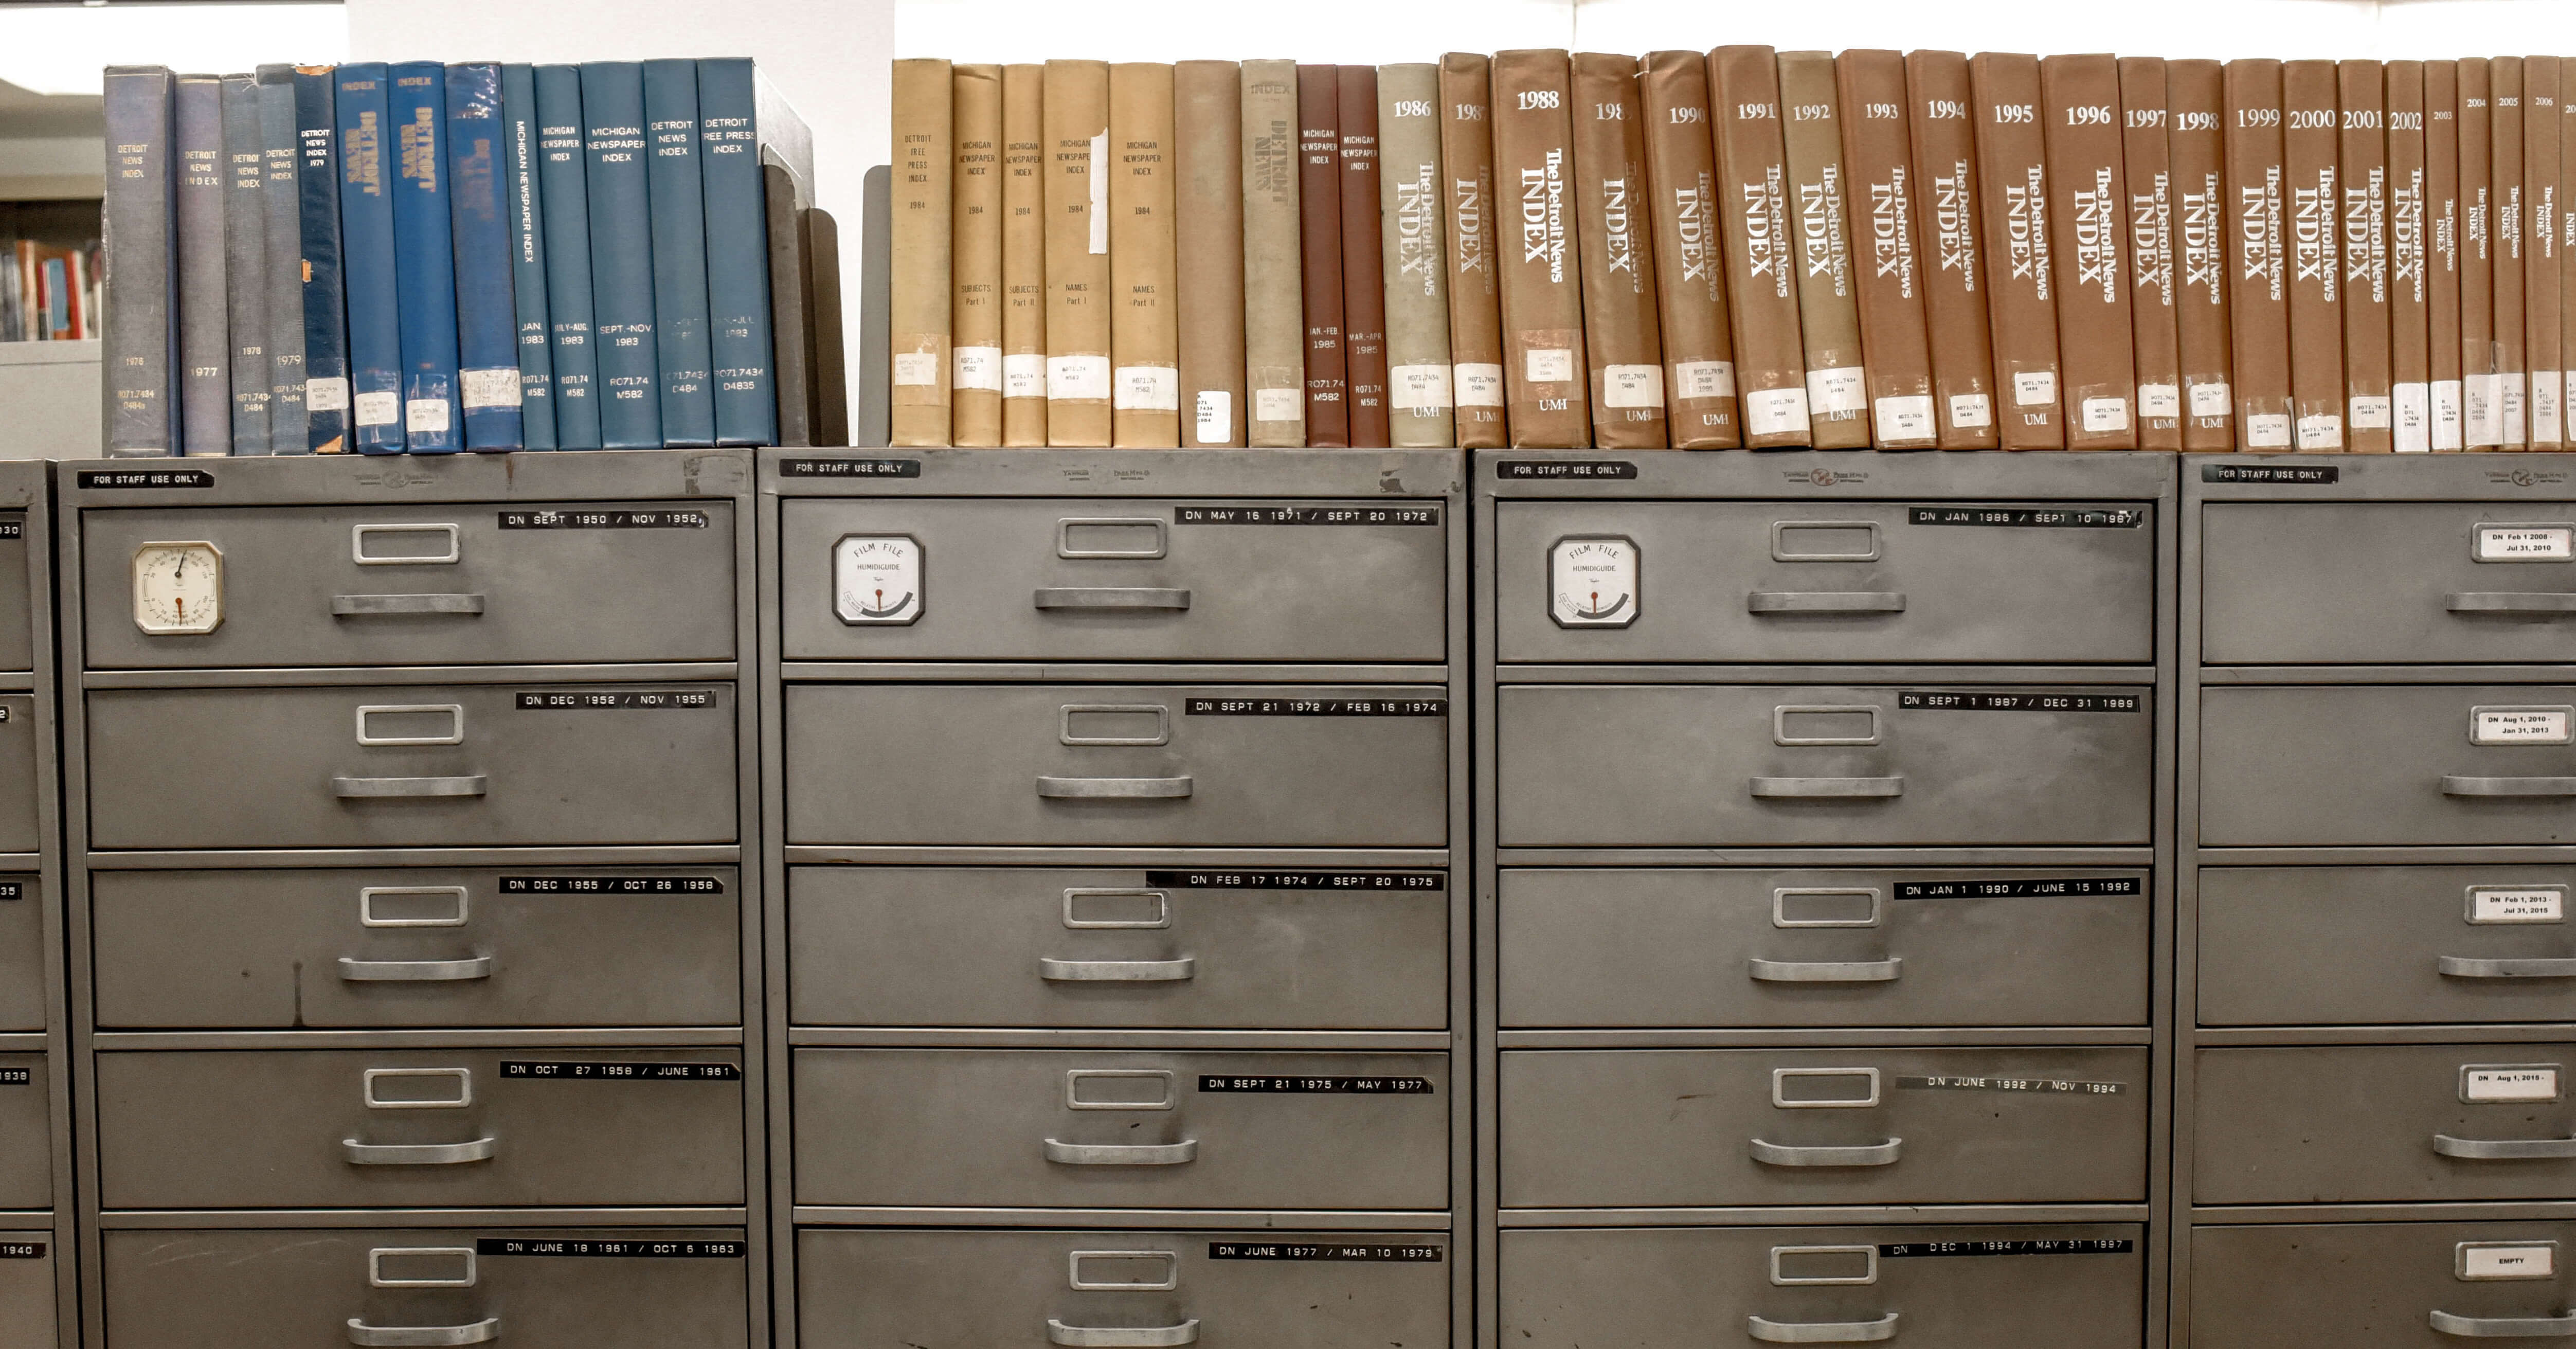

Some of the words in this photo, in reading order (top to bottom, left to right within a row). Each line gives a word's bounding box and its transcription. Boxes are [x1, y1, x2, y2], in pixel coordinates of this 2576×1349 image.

[1518, 91, 1559, 110] 1988
[2467, 98, 2485, 107] 2004
[2499, 98, 2518, 106] 2005
[2535, 97, 2553, 106] 2006
[1394, 100, 1430, 117] 1986
[1738, 103, 1776, 119] 1991
[1793, 104, 1830, 121] 1992
[1866, 103, 1898, 119] 1993
[1928, 100, 1967, 119] 1994
[1995, 104, 2033, 123] 1995
[2066, 105, 2111, 125] 1996
[2127, 110, 2166, 128] 1997
[2238, 109, 2280, 128] 1999
[2290, 110, 2335, 129] 2000
[2343, 110, 2383, 130] 2001
[2434, 111, 2452, 120] 2003
[651, 121, 693, 130] DETROIT
[2390, 112, 2422, 130] 2002
[301, 129, 330, 137] DETROIT
[592, 127, 640, 136] MICHIGAN
[1303, 129, 1334, 138] MICHIGAN
[658, 134, 687, 142] NEWS
[905, 134, 931, 143] DETROIT
[118, 144, 148, 153] DETROIT
[516, 121, 527, 169] MICHIGAN
[588, 140, 645, 149] NEWSPAPER
[1302, 142, 1337, 151] NEWSPAPER
[659, 147, 688, 156] INDEX
[910, 148, 925, 156] FREE
[123, 156, 143, 165] NEWS
[602, 153, 632, 162] INDEX
[1123, 154, 1161, 163] NEWSPAPER
[1310, 156, 1329, 164] INDEX
[908, 161, 927, 169] PRESS
[1546, 148, 1562, 180] The
[122, 169, 144, 177] INDEX
[908, 174, 927, 183] INDEX
[1823, 164, 1838, 194] The
[2319, 166, 2334, 198] The
[519, 172, 531, 231] NEWSPAPER
[910, 201, 925, 209] 1984
[1135, 207, 1150, 215] 1984
[1547, 180, 1565, 245] Detroit
[2445, 199, 2454, 216] The
[1521, 167, 1548, 264] INDEX
[1826, 194, 1844, 252] Detroit
[2536, 205, 2545, 238] INDEX
[1800, 181, 1833, 278] INDEX
[2320, 199, 2336, 257] Detroit
[2445, 216, 2454, 247] Detroit
[2295, 187, 2320, 281] INDEX
[2437, 219, 2446, 253] INDEX
[524, 233, 533, 262] INDEX
[1550, 240, 1565, 283] News
[2446, 247, 2455, 272] News
[1832, 253, 1847, 297] News
[2322, 257, 2337, 302] News
[616, 337, 638, 346] 1983
[1314, 340, 1336, 349] 1985
[243, 347, 261, 355] 1978
[276, 355, 301, 366] 1979
[191, 367, 218, 376] 1977
[724, 381, 754, 390] D4835
[617, 390, 643, 399] M582
[1314, 392, 1339, 401] M582
[796, 464, 813, 472] FOR
[819, 463, 849, 472] STAFF
[854, 464, 873, 473] USE
[878, 464, 902, 473] ONLY
[94, 476, 111, 484] FOR
[116, 475, 146, 484] STAFF
[151, 475, 169, 483] USE
[174, 475, 199, 483] ONLY
[509, 516, 525, 525] DN
[534, 515, 565, 524] SEPT
[576, 515, 606, 524] 1950
[632, 515, 656, 524] NOV
[666, 514, 697, 523] 1952
[853, 543, 875, 557] FILM
[883, 543, 904, 558] FILE
[1196, 702, 1212, 711] DN
[1221, 702, 1253, 711] SEPT
[1263, 703, 1277, 711] 21
[1290, 703, 1320, 711] 1972
[1347, 703, 1371, 712] FEB
[1381, 703, 1395, 712] 16
[1406, 703, 1436, 712] 1974
[1904, 696, 1919, 705] DN
[1929, 696, 1960, 705] SEPT
[1988, 697, 2017, 706] 1987
[2044, 698, 2067, 707] DEC
[2077, 699, 2091, 708] 31
[2103, 699, 2133, 708] 1989
[1209, 1079, 1224, 1088] DN
[1234, 1080, 1266, 1088] SEPT
[1275, 1080, 1289, 1088] 21
[1301, 1080, 1331, 1089] 1975
[1357, 1081, 1381, 1089] MAY
[1392, 1081, 1422, 1089] 1977
[1928, 1076, 1945, 1086] DN
[1954, 1077, 1985, 1087] JUNE
[1997, 1081, 2026, 1089] 1992
[2052, 1082, 2076, 1090] NOV
[2086, 1084, 2115, 1093] 1994
[3, 1246, 32, 1254] 1940
[507, 1243, 523, 1251] DN
[532, 1243, 563, 1252] JUNE
[574, 1244, 588, 1252] 18
[599, 1244, 627, 1252] 1961
[654, 1245, 677, 1253] OCT
[687, 1245, 693, 1253] 6
[705, 1245, 734, 1253] 1963
